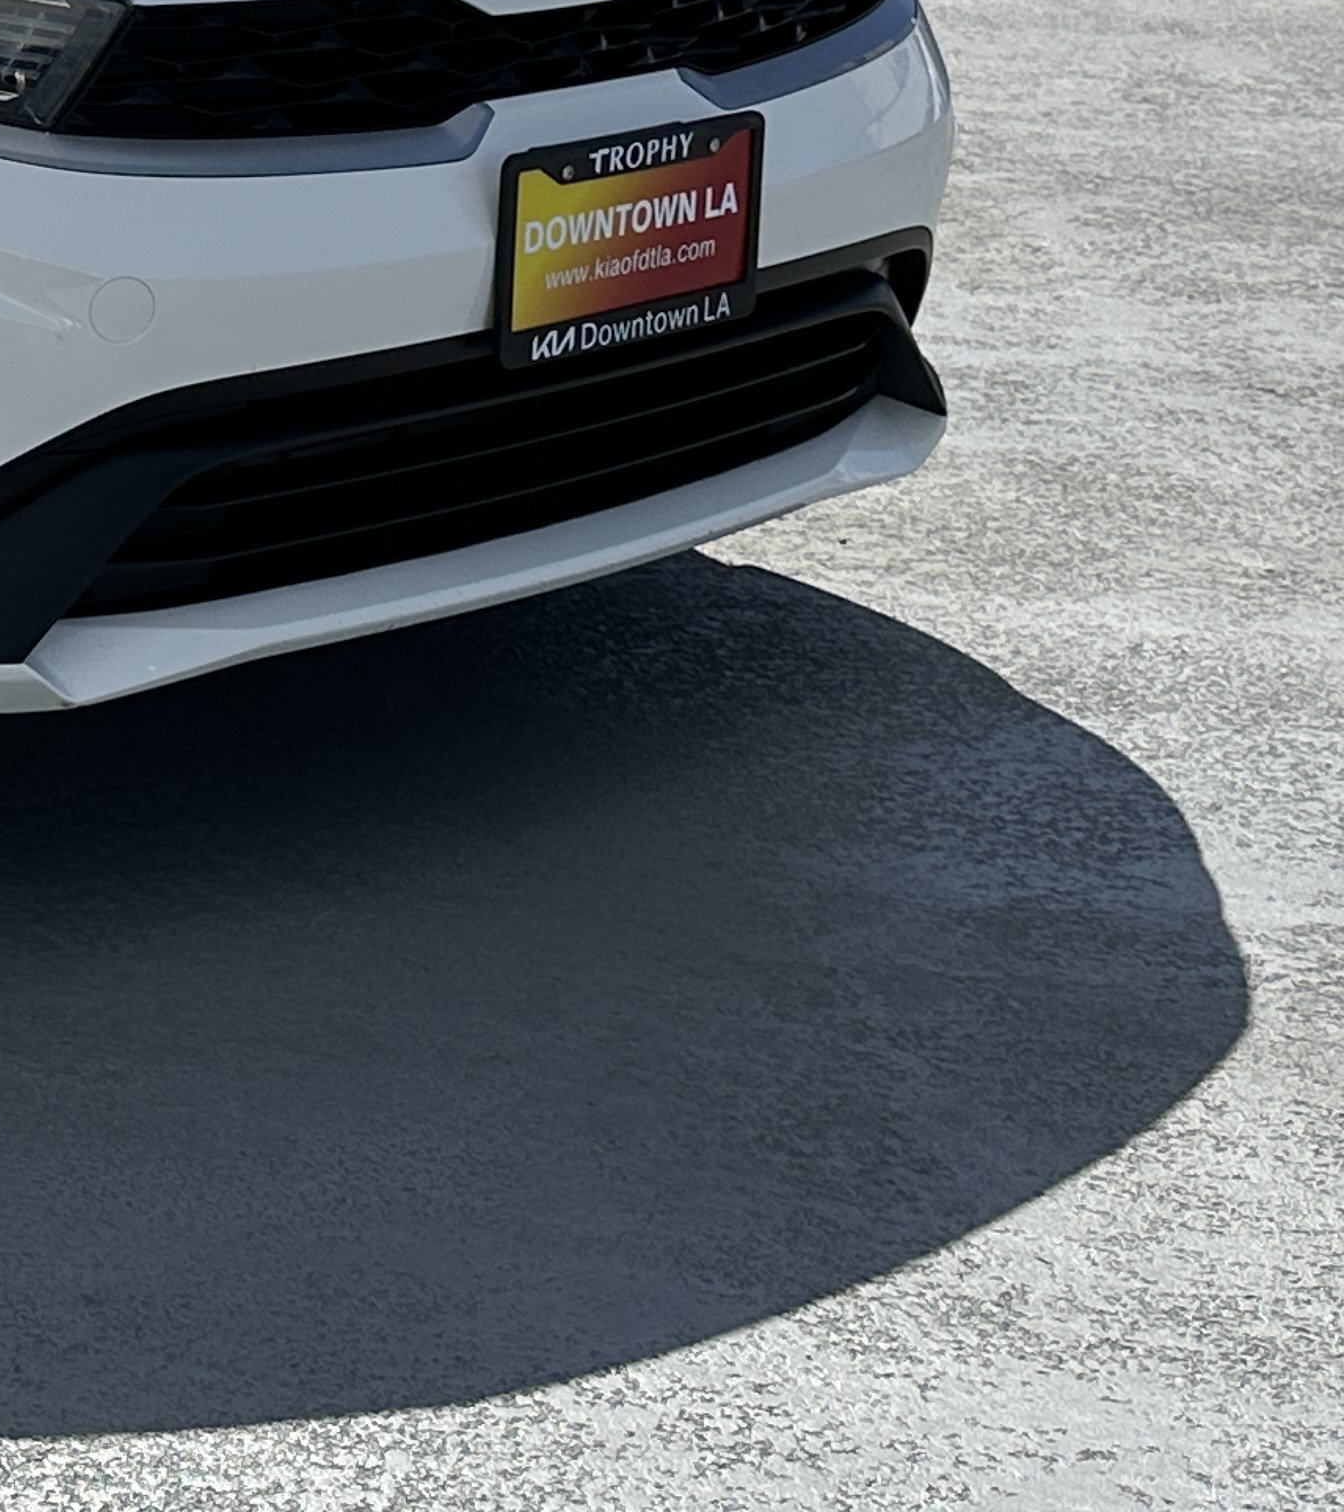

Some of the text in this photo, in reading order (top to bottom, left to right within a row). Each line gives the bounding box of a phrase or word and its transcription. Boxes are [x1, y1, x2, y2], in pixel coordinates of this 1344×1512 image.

[589, 132, 695, 174] TROPHY
[523, 183, 738, 254] DOWNTOWN LA
[544, 238, 716, 289] www.kiaofdtla.com
[580, 303, 699, 351] Downtown
[703, 292, 731, 323] LA
